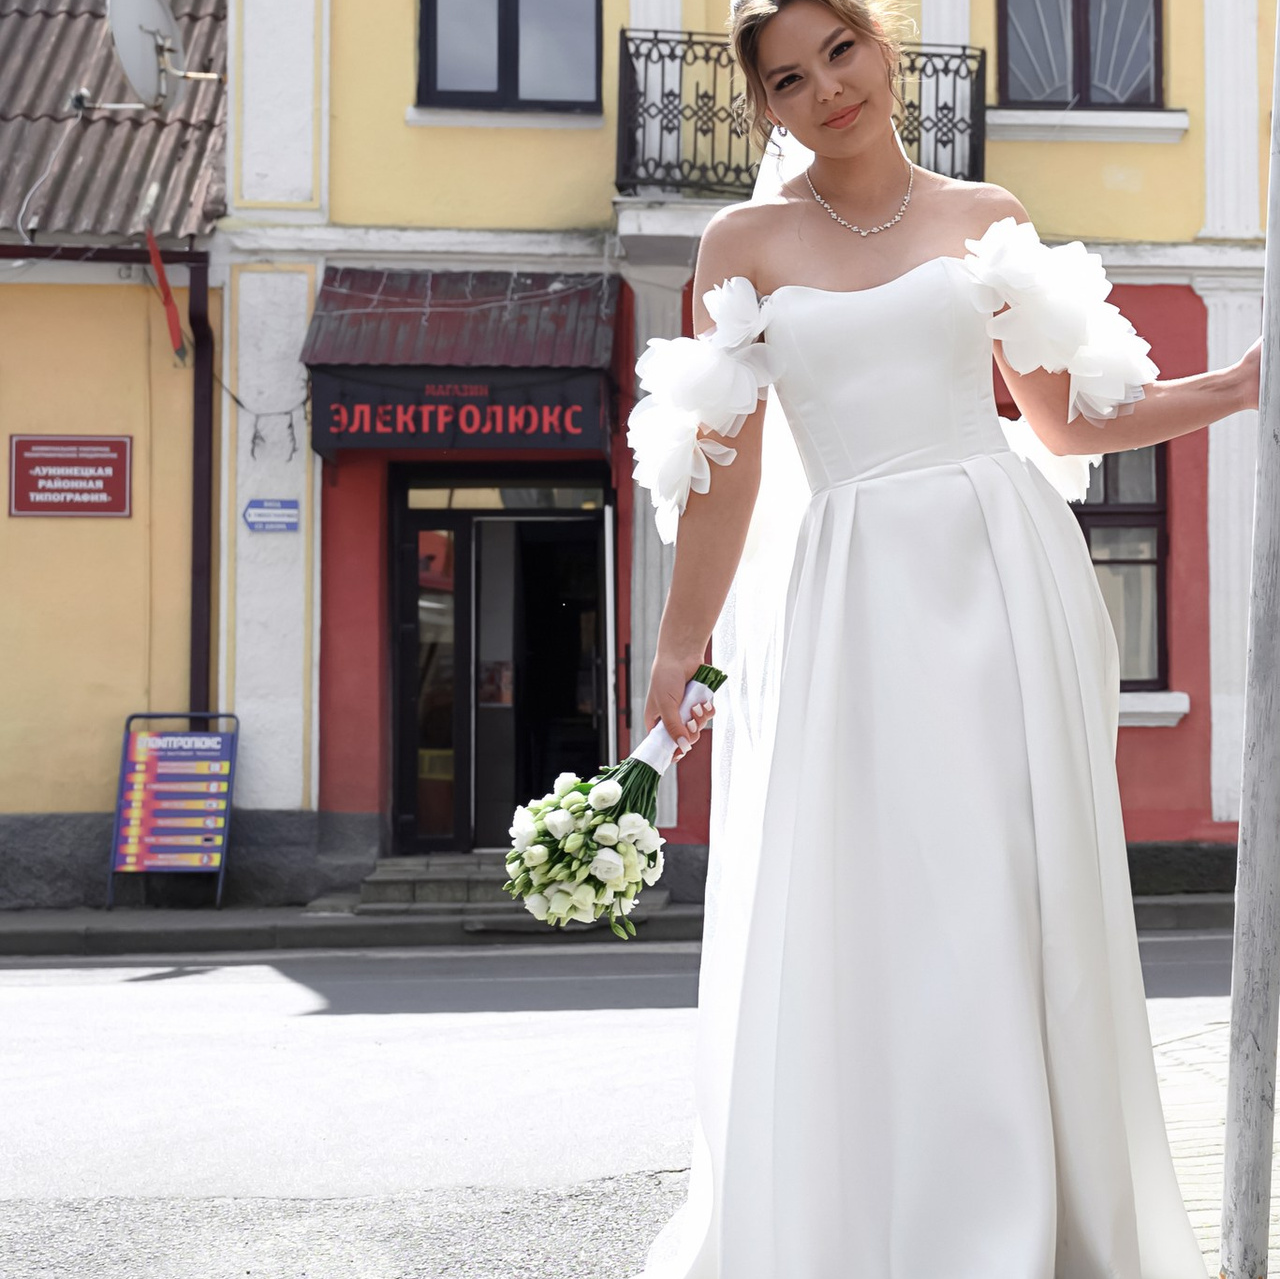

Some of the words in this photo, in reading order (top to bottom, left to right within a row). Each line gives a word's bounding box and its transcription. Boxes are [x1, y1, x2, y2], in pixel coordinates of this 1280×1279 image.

[424, 383, 490, 397] МАГАЗИН
[329, 402, 583, 435] ЭЛЕКТРОЛЮКС
[37, 477, 104, 490] РАЙОННАЯ
